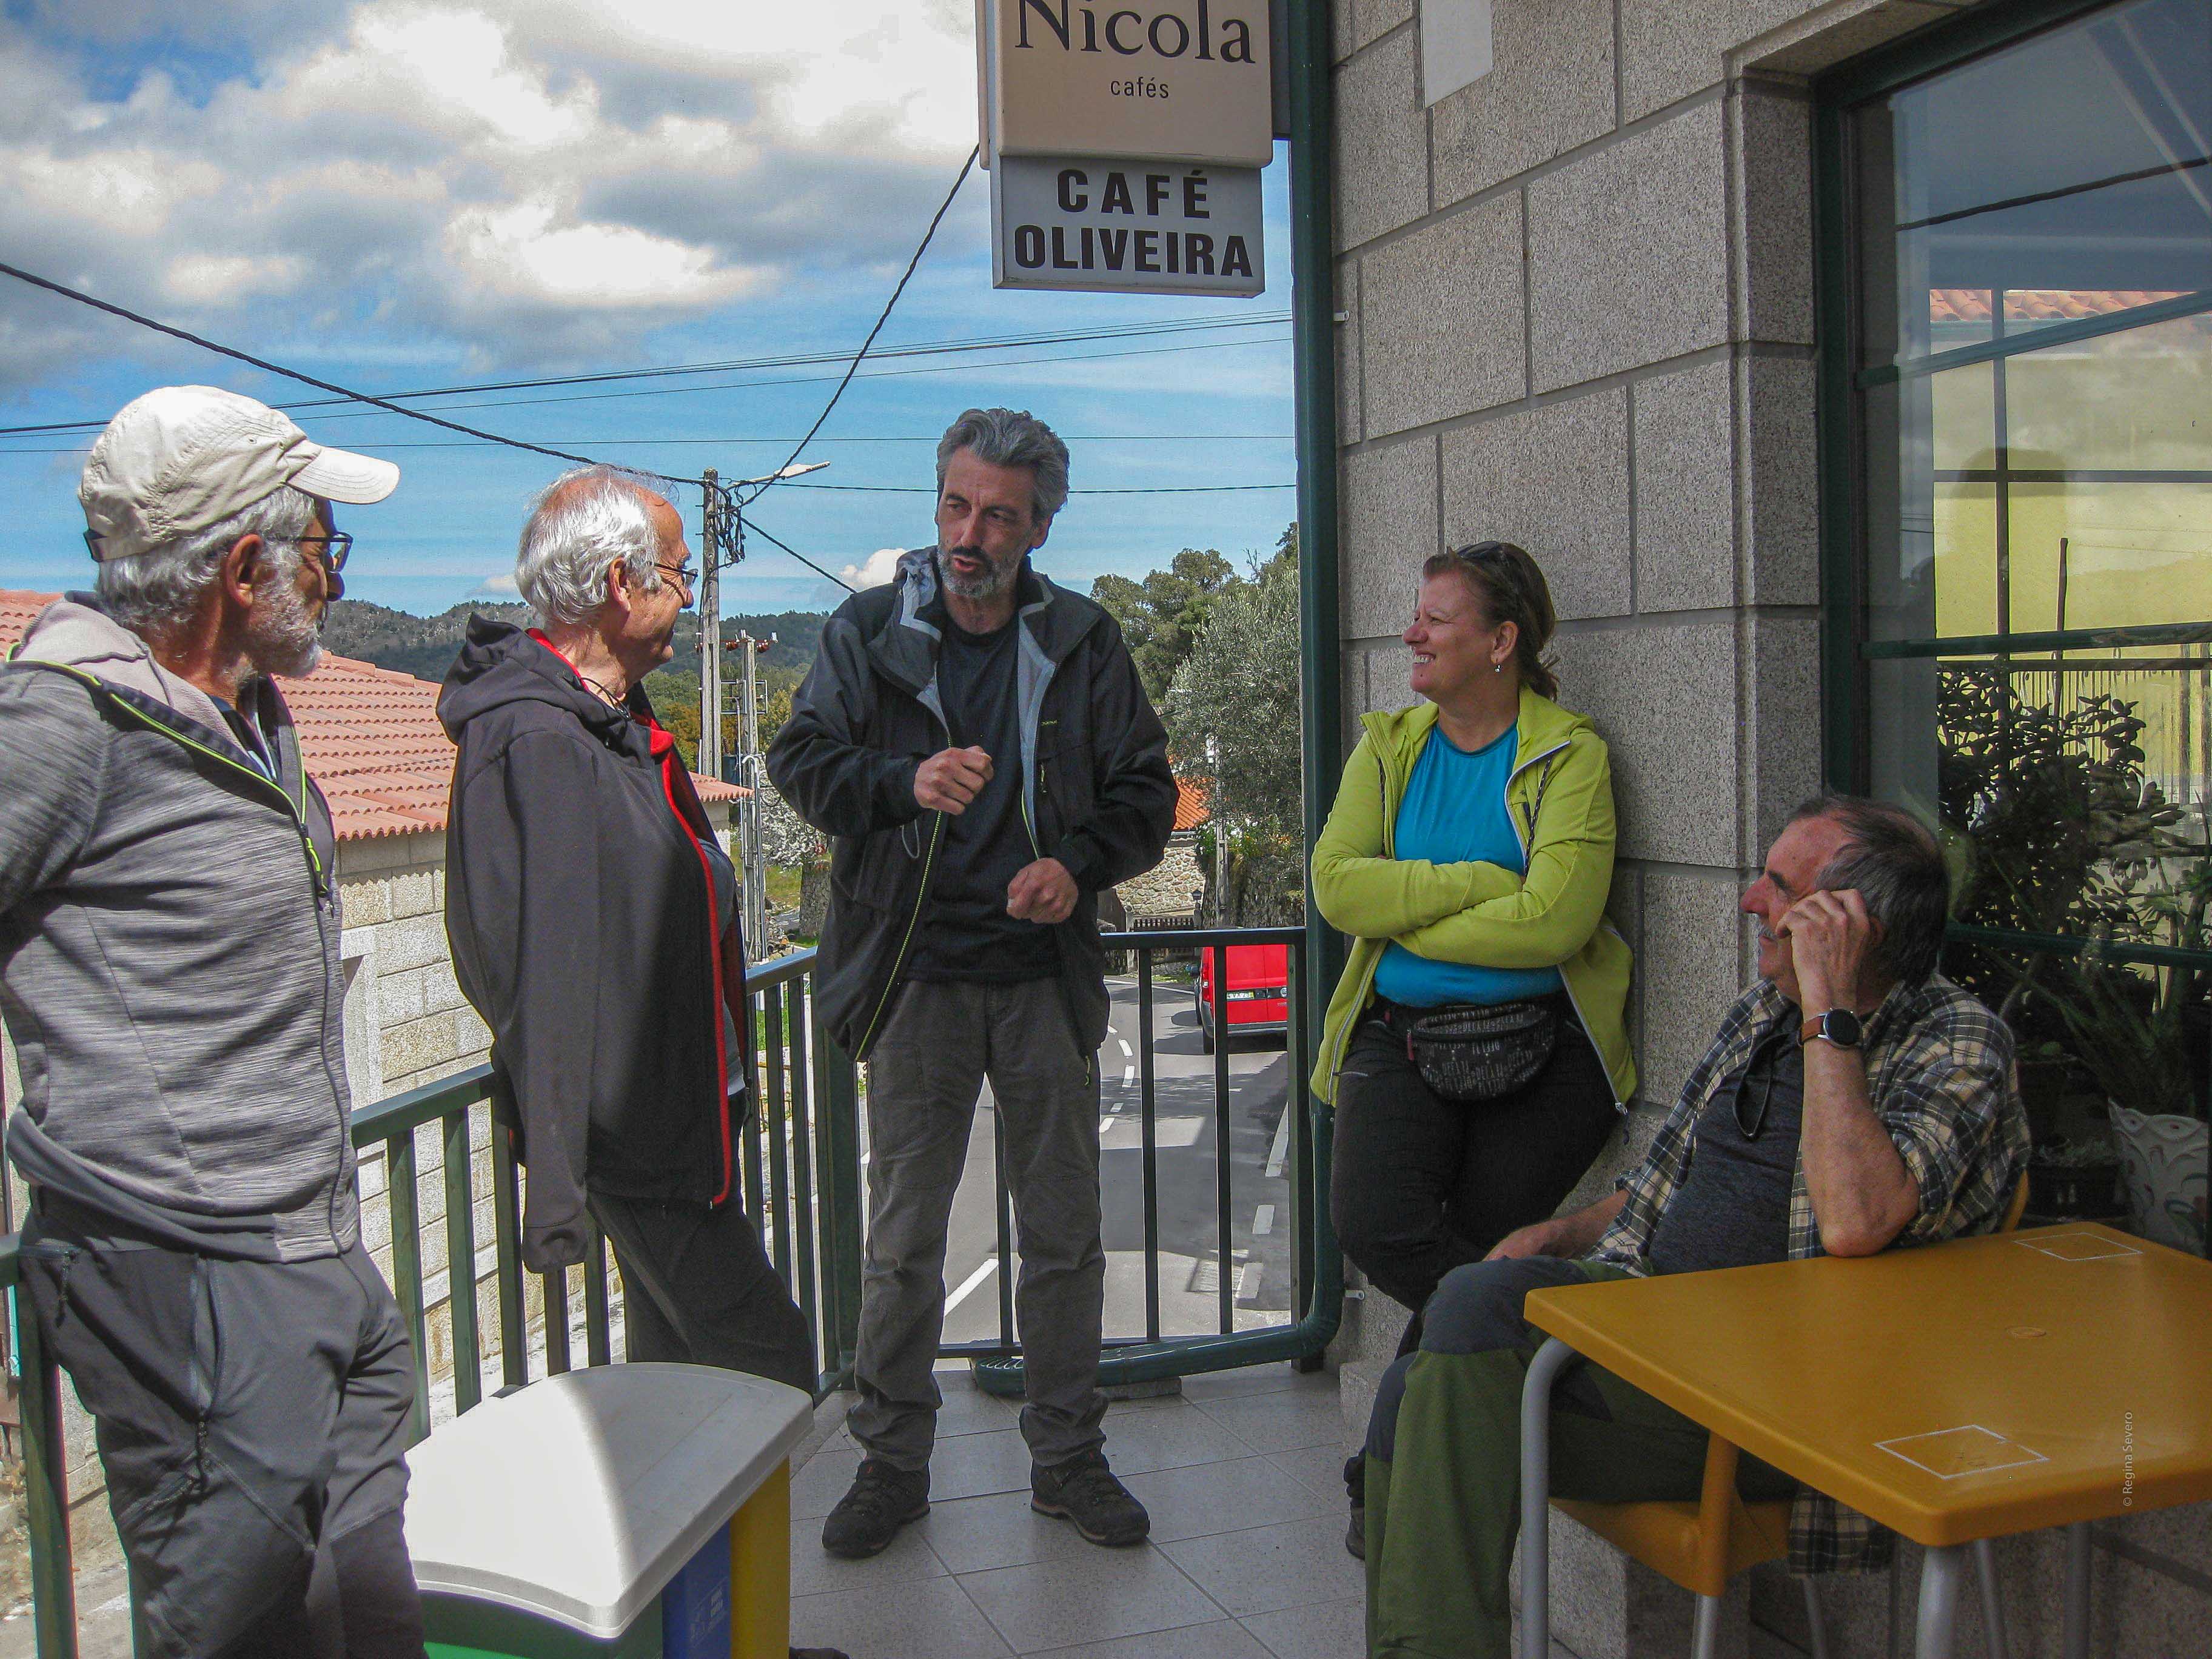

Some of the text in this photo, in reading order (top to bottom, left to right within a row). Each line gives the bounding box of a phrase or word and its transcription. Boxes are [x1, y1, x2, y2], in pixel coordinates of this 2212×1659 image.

[1014, 0, 1256, 64] Nicola
[1110, 76, 1169, 99] cafés
[1057, 169, 1210, 219] CAFÉ
[1014, 224, 1253, 277] OLIVEIRA
